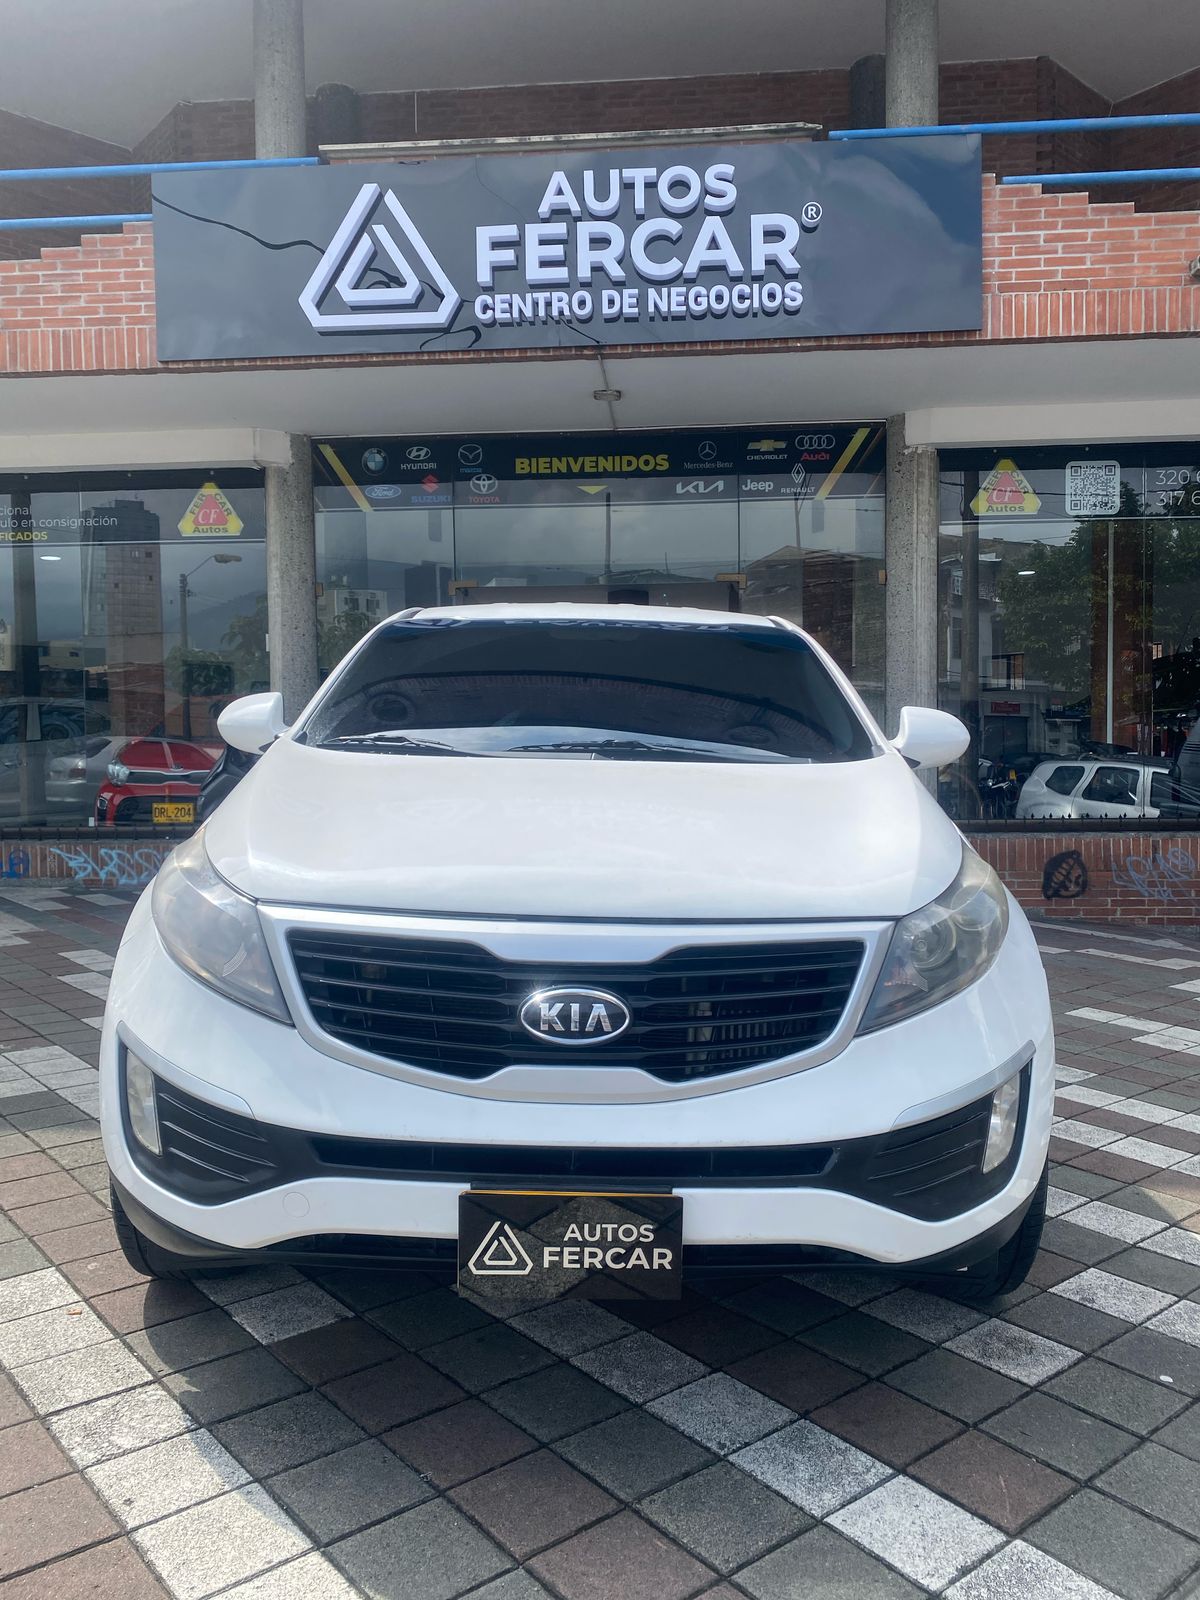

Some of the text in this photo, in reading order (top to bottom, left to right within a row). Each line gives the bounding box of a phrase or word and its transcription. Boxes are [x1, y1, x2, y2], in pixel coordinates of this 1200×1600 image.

[538, 163, 737, 217] AUTOS
[475, 213, 801, 287] FERCAR
[474, 281, 803, 326] CENTRO DE NEGOCIOS
[515, 454, 670, 474] BIENVENIDOS
[683, 461, 734, 470] Mercedes-Benz
[1155, 469, 1190, 485] 320
[742, 479, 774, 492] Jeep
[411, 495, 451, 503] SUZUKI
[1155, 490, 1186, 506] 317
[198, 508, 219, 524] CF
[985, 505, 1025, 513] Autos
[21, 518, 36, 528] en
[39, 515, 118, 529] consignación
[539, 1002, 612, 1031] KIA
[563, 1222, 655, 1243] AUTOS
[543, 1246, 673, 1271] FERCAR
